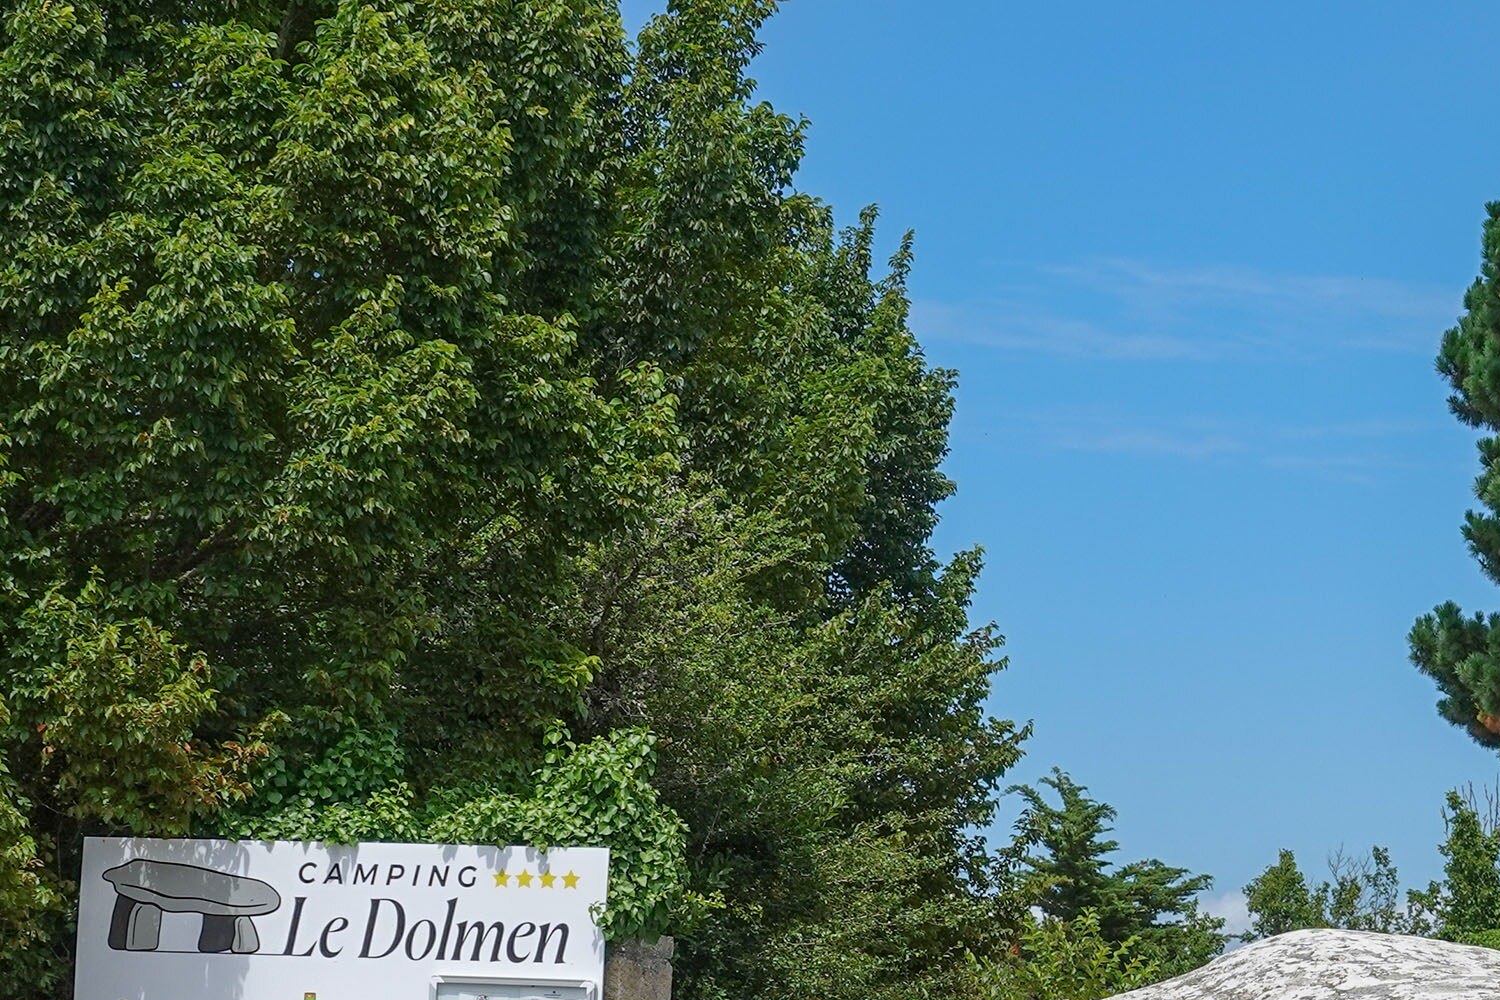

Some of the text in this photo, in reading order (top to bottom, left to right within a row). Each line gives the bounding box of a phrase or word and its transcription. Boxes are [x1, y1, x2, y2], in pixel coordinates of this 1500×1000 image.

[298, 862, 478, 888] CAMPING
[282, 896, 570, 965] Le Dolmen
